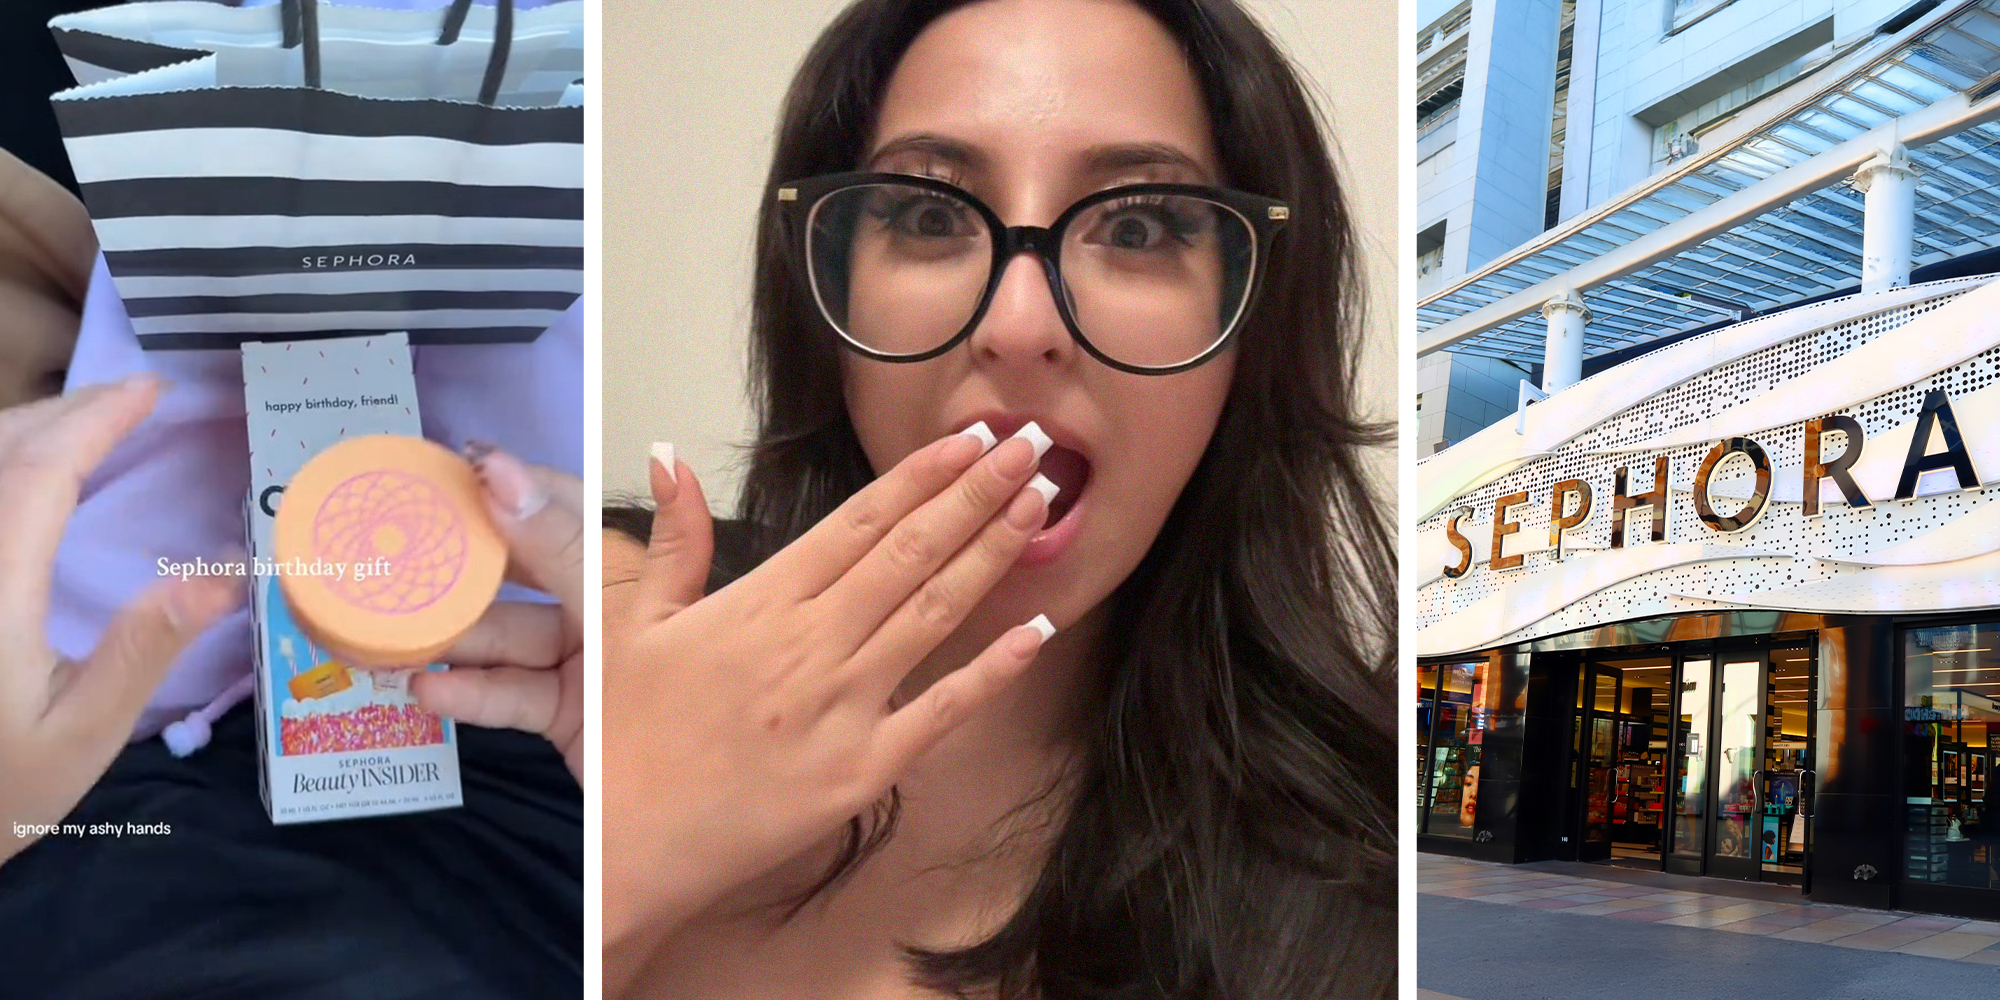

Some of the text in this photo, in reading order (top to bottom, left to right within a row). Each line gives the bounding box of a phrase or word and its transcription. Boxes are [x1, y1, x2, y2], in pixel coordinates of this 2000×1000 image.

[302, 253, 416, 269] SEPHORA
[265, 394, 399, 413] happy birthday, friend!
[1442, 389, 1984, 580] SEPHORA
[339, 756, 391, 768] SEPHORA
[293, 762, 440, 794] Beauty INSIDER
